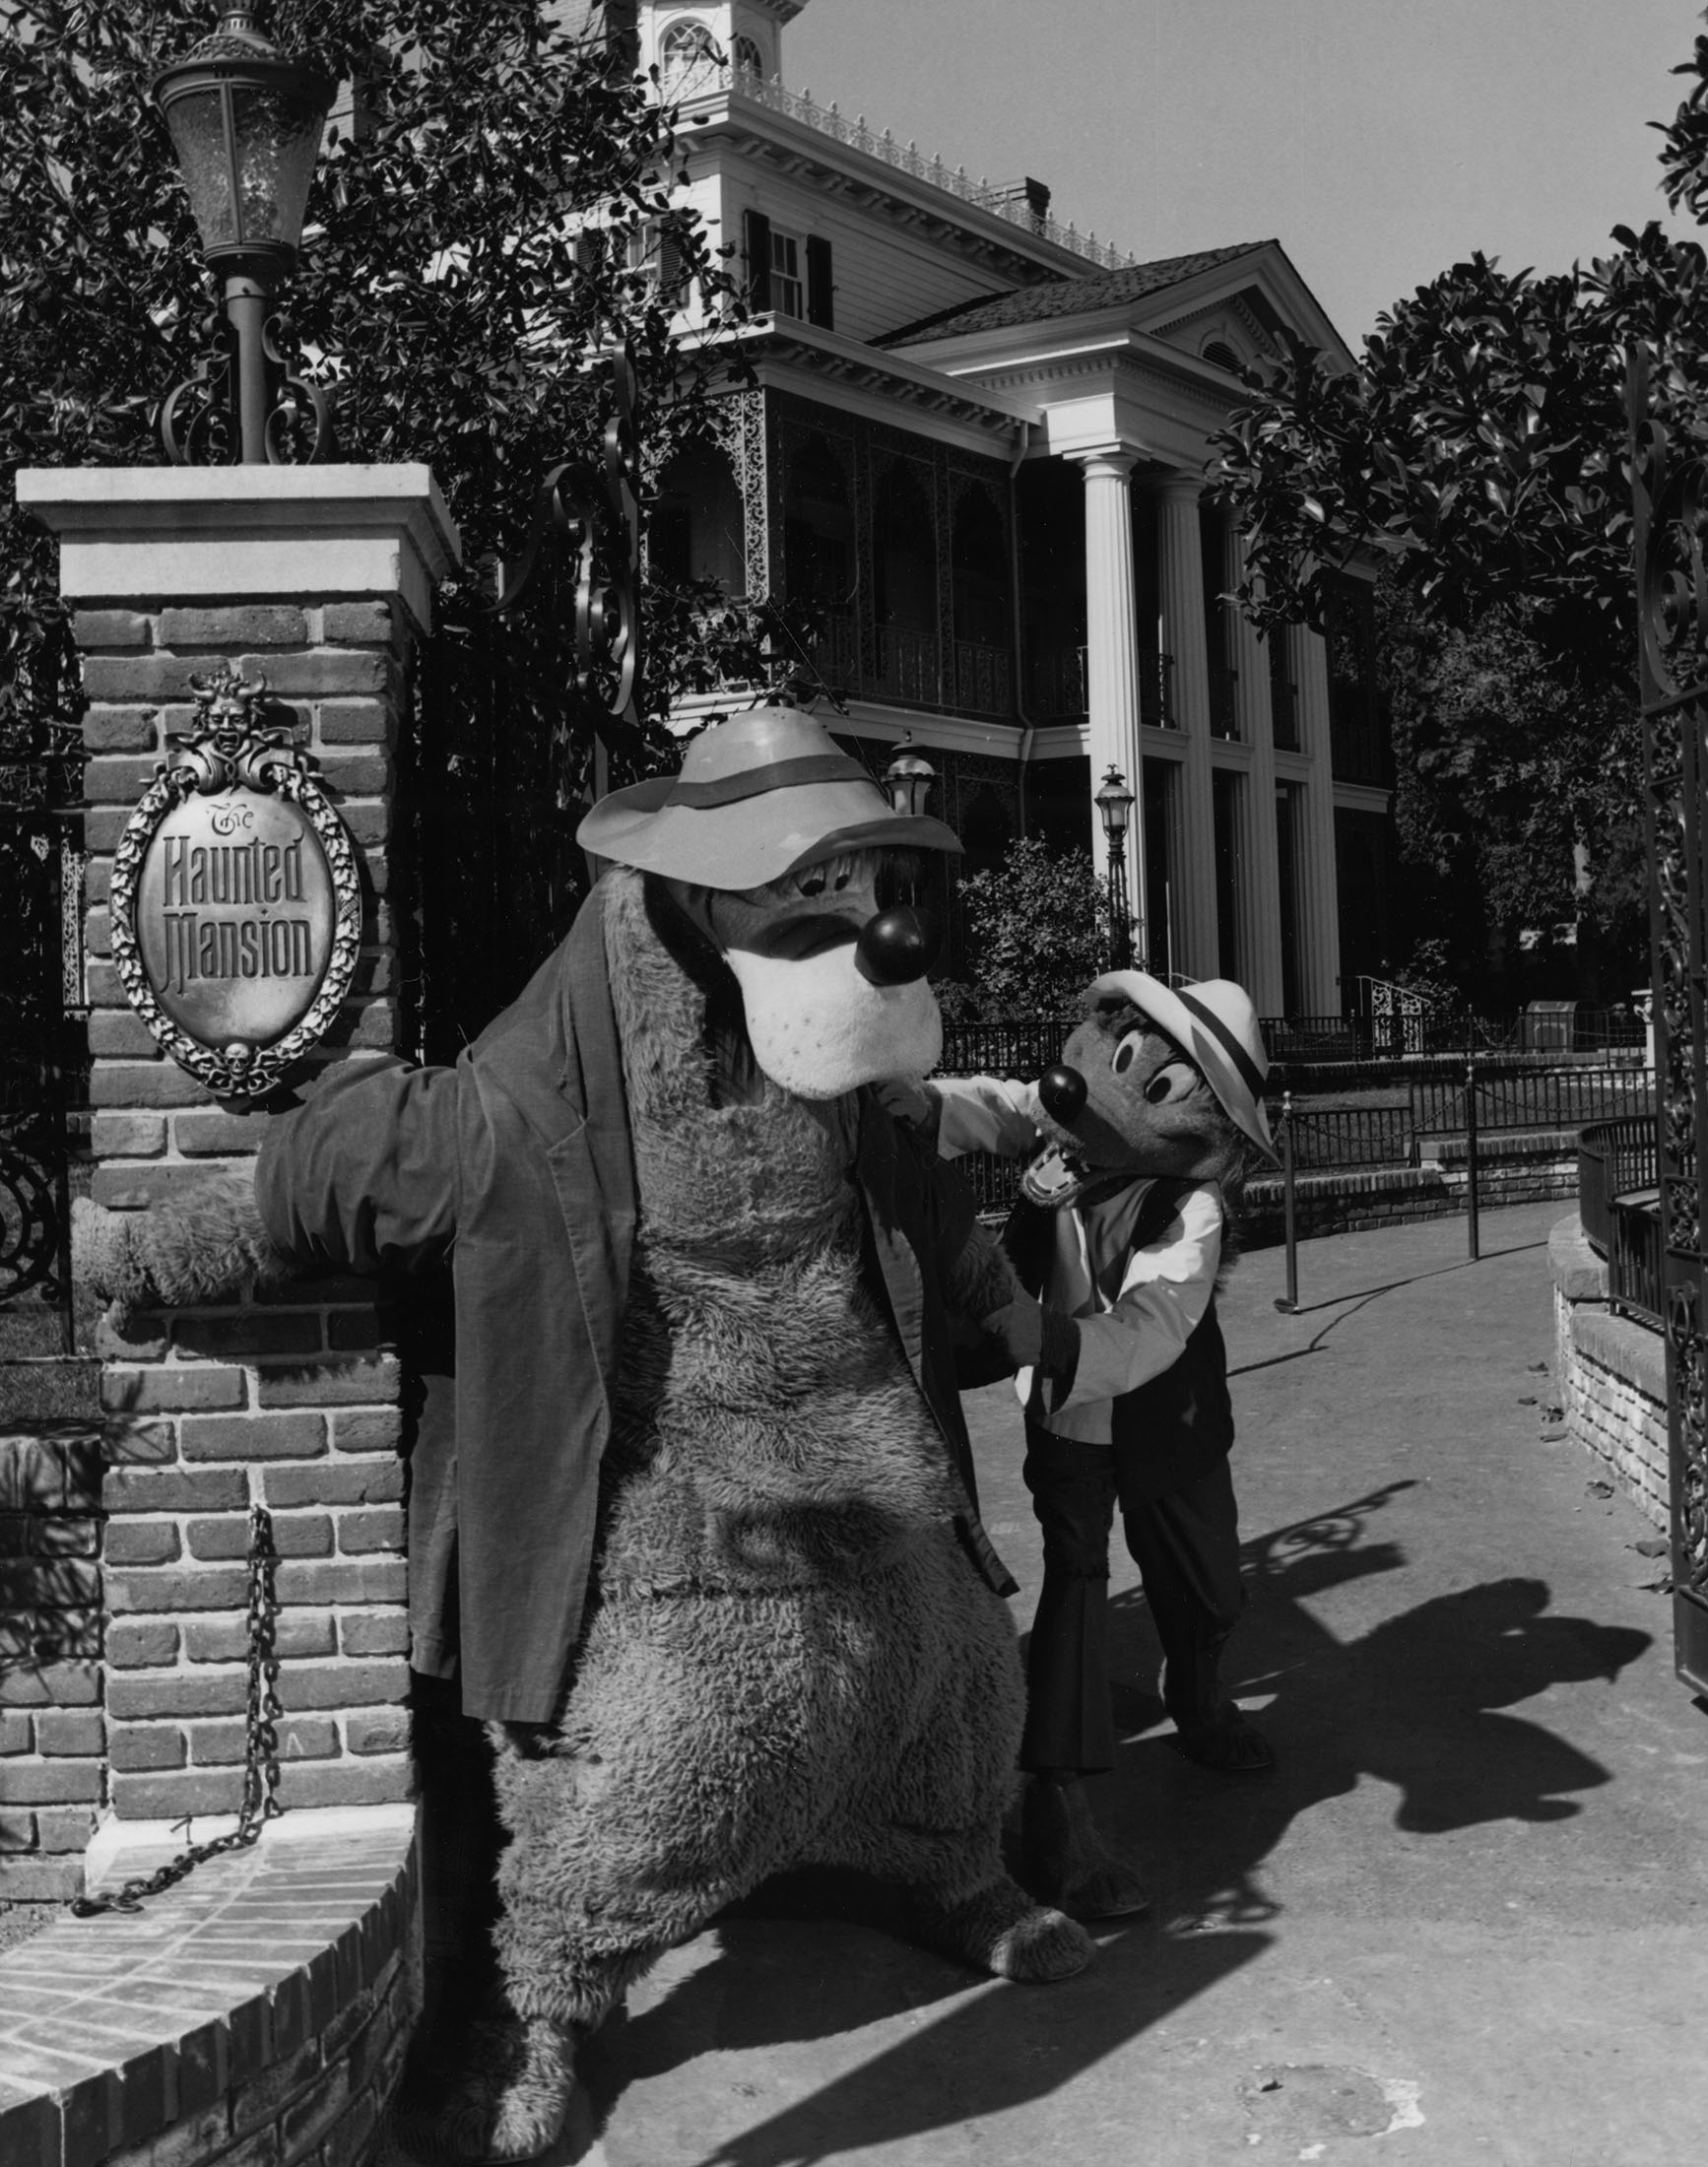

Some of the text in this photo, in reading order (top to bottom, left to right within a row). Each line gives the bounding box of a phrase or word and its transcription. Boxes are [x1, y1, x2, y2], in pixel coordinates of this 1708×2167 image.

[206, 803, 254, 836] The
[163, 828, 307, 906] Haunted
[159, 909, 314, 995] Mansion
